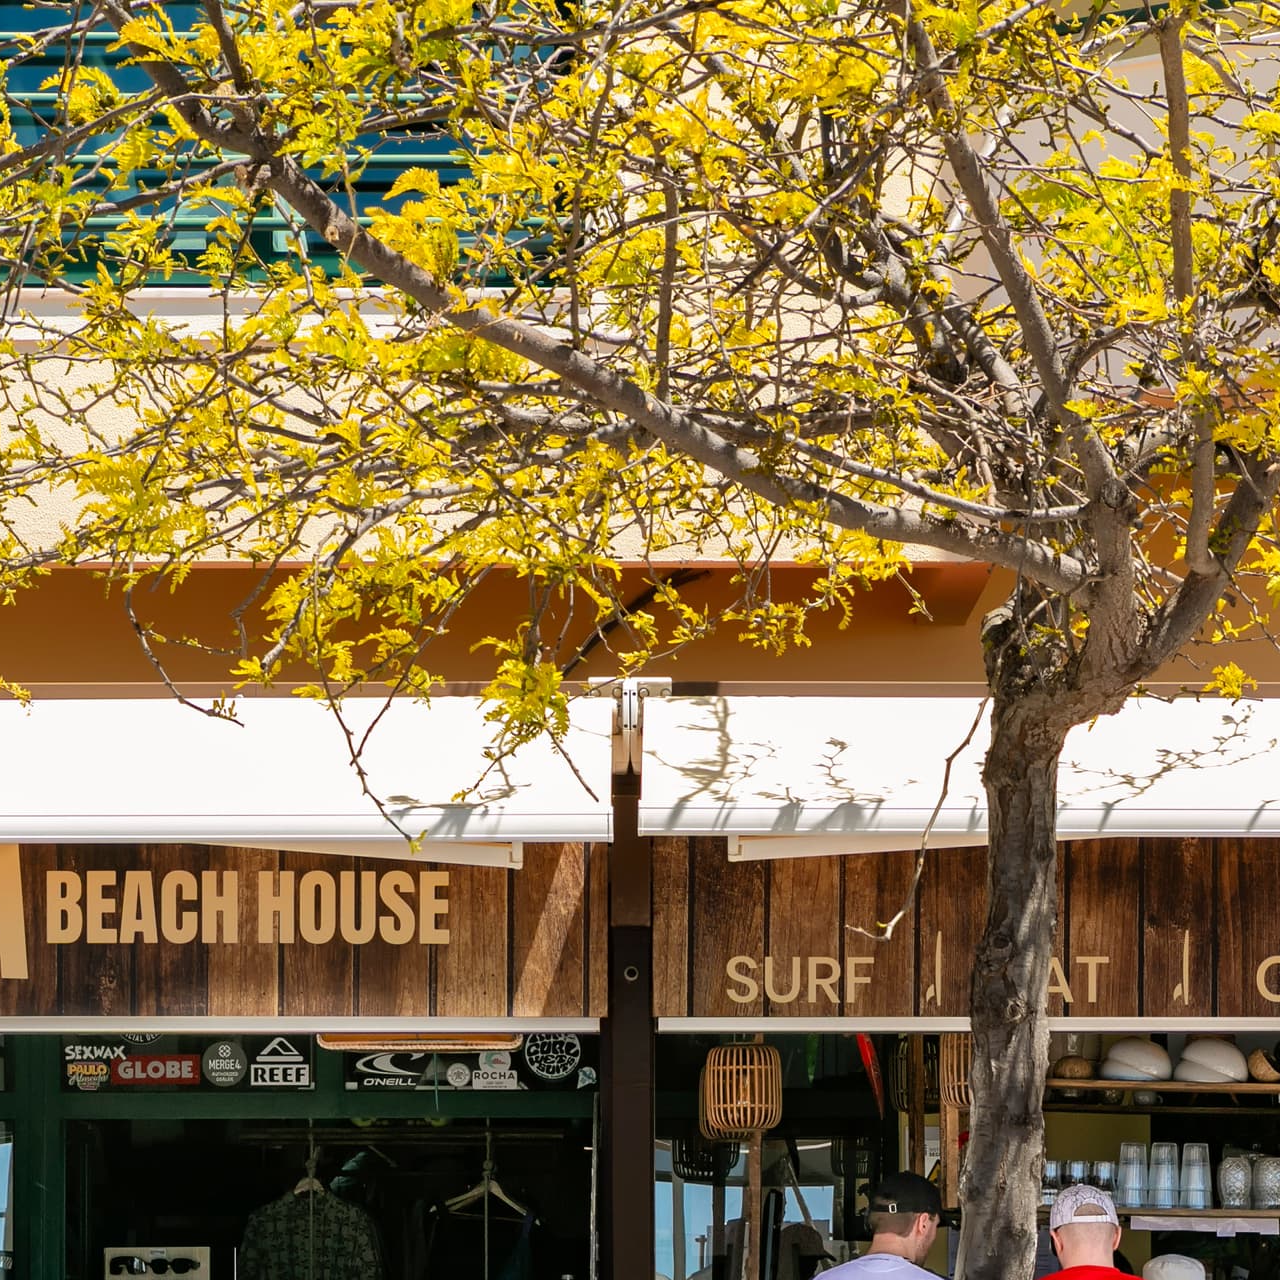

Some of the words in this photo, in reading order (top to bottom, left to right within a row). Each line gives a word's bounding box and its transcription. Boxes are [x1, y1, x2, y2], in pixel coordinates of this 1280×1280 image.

[45, 870, 238, 945] BEACH
[258, 870, 450, 945] HOUSE
[725, 955, 875, 1004] SURF
[64, 1044, 128, 1061] SEXWAX
[67, 1063, 108, 1077] PAULO
[118, 1060, 194, 1080] GLOBE
[208, 1059, 242, 1070] MERGE4
[253, 1066, 308, 1083] REEF
[363, 1077, 417, 1086] O'NEILL
[473, 1071, 516, 1081] ROCHA
